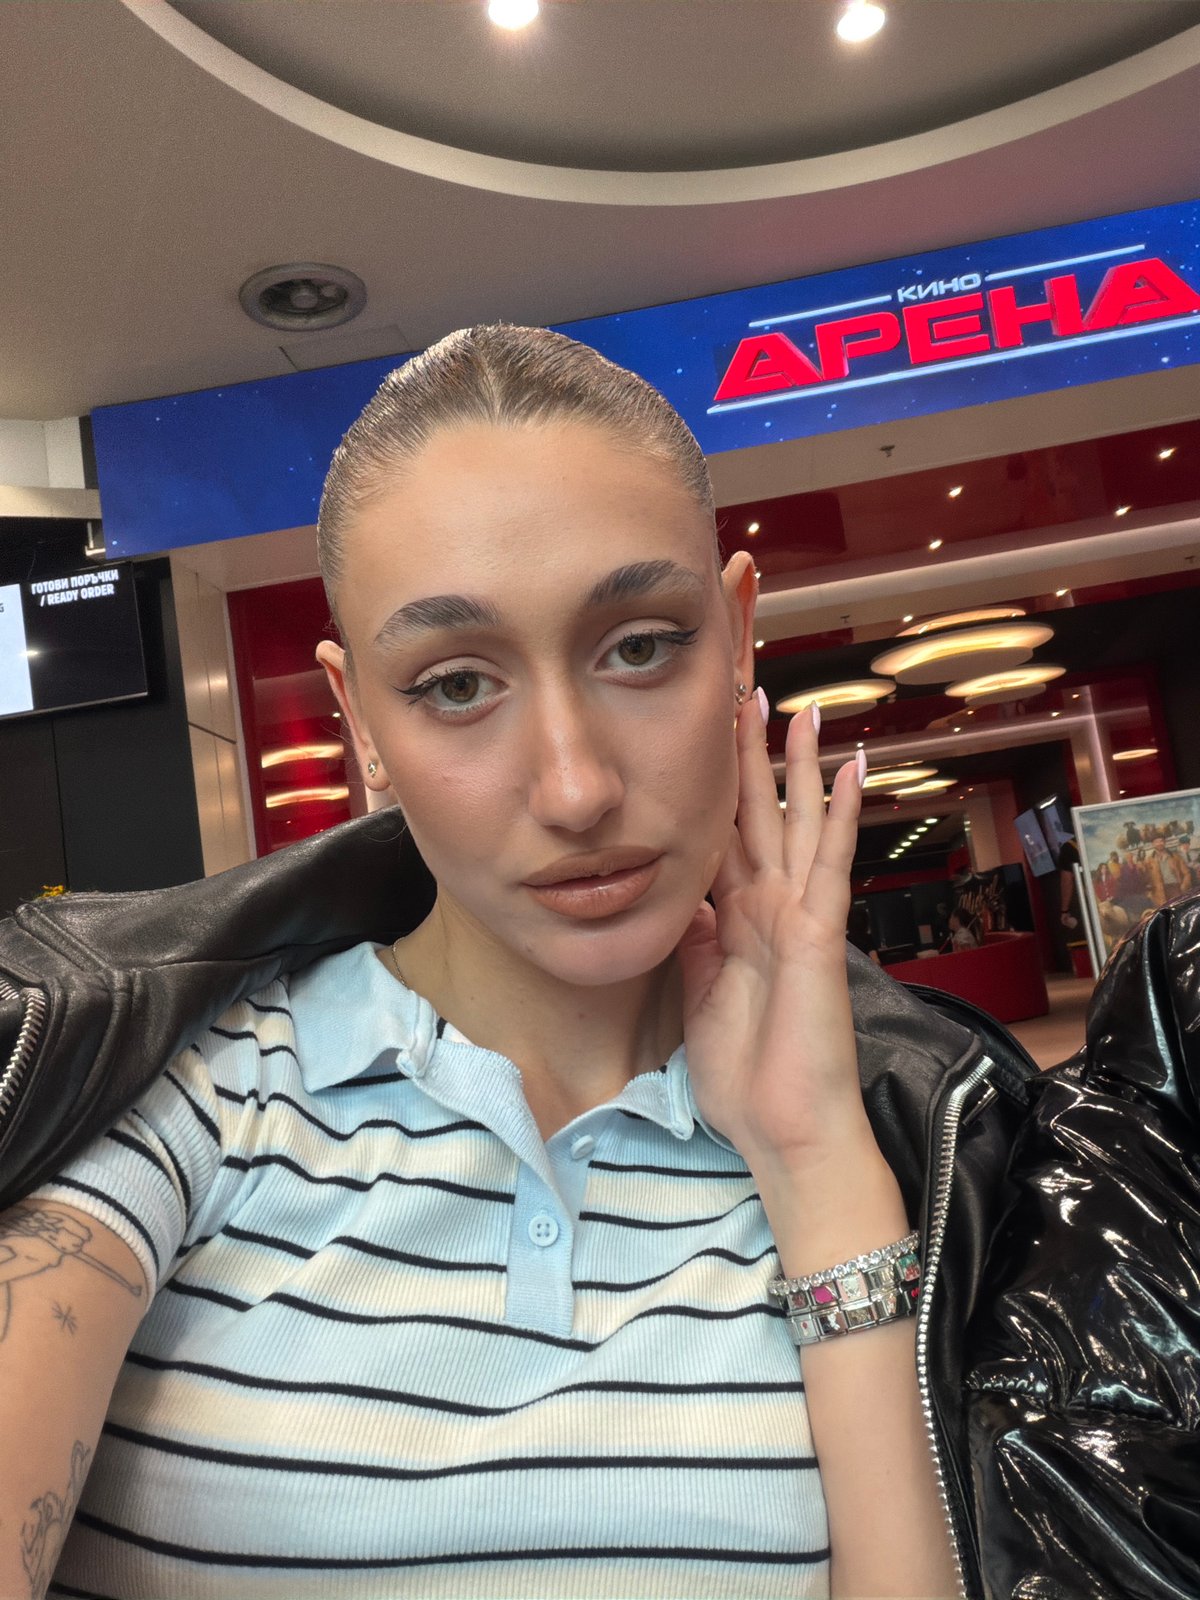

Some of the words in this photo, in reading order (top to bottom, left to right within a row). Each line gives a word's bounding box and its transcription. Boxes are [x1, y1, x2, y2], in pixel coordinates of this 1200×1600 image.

[897, 273, 981, 303] КИНО
[714, 257, 1200, 400] АРЕНА
[31, 578, 69, 595] ГОТОВИ
[70, 569, 119, 588] ПОРЪЧКИ
[47, 589, 79, 606] READY
[80, 583, 115, 600] ORDER
